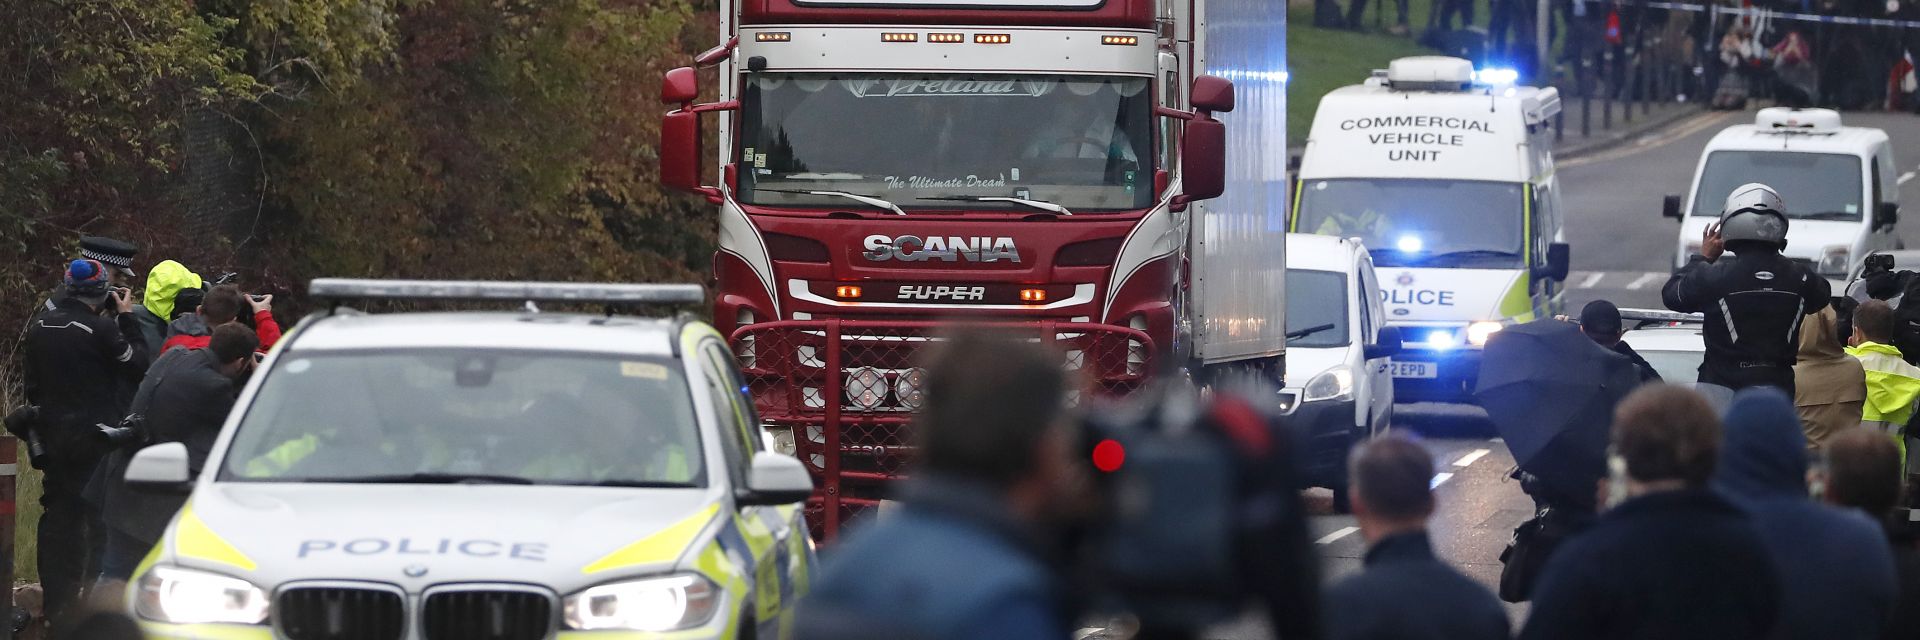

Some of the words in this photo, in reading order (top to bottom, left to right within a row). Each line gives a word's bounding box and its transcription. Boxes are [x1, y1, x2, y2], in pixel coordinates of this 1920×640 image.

[1340, 116, 1495, 134] COMMERCIAL
[1368, 133, 1464, 146] VEHICLE
[1388, 150, 1442, 162] UNIT
[884, 175, 905, 190] The
[908, 175, 962, 189] Ultimate
[966, 174, 1006, 188] Dream
[862, 234, 1022, 263] SCANIA
[1400, 364, 1426, 375] EPD
[297, 538, 550, 563] POLICE
